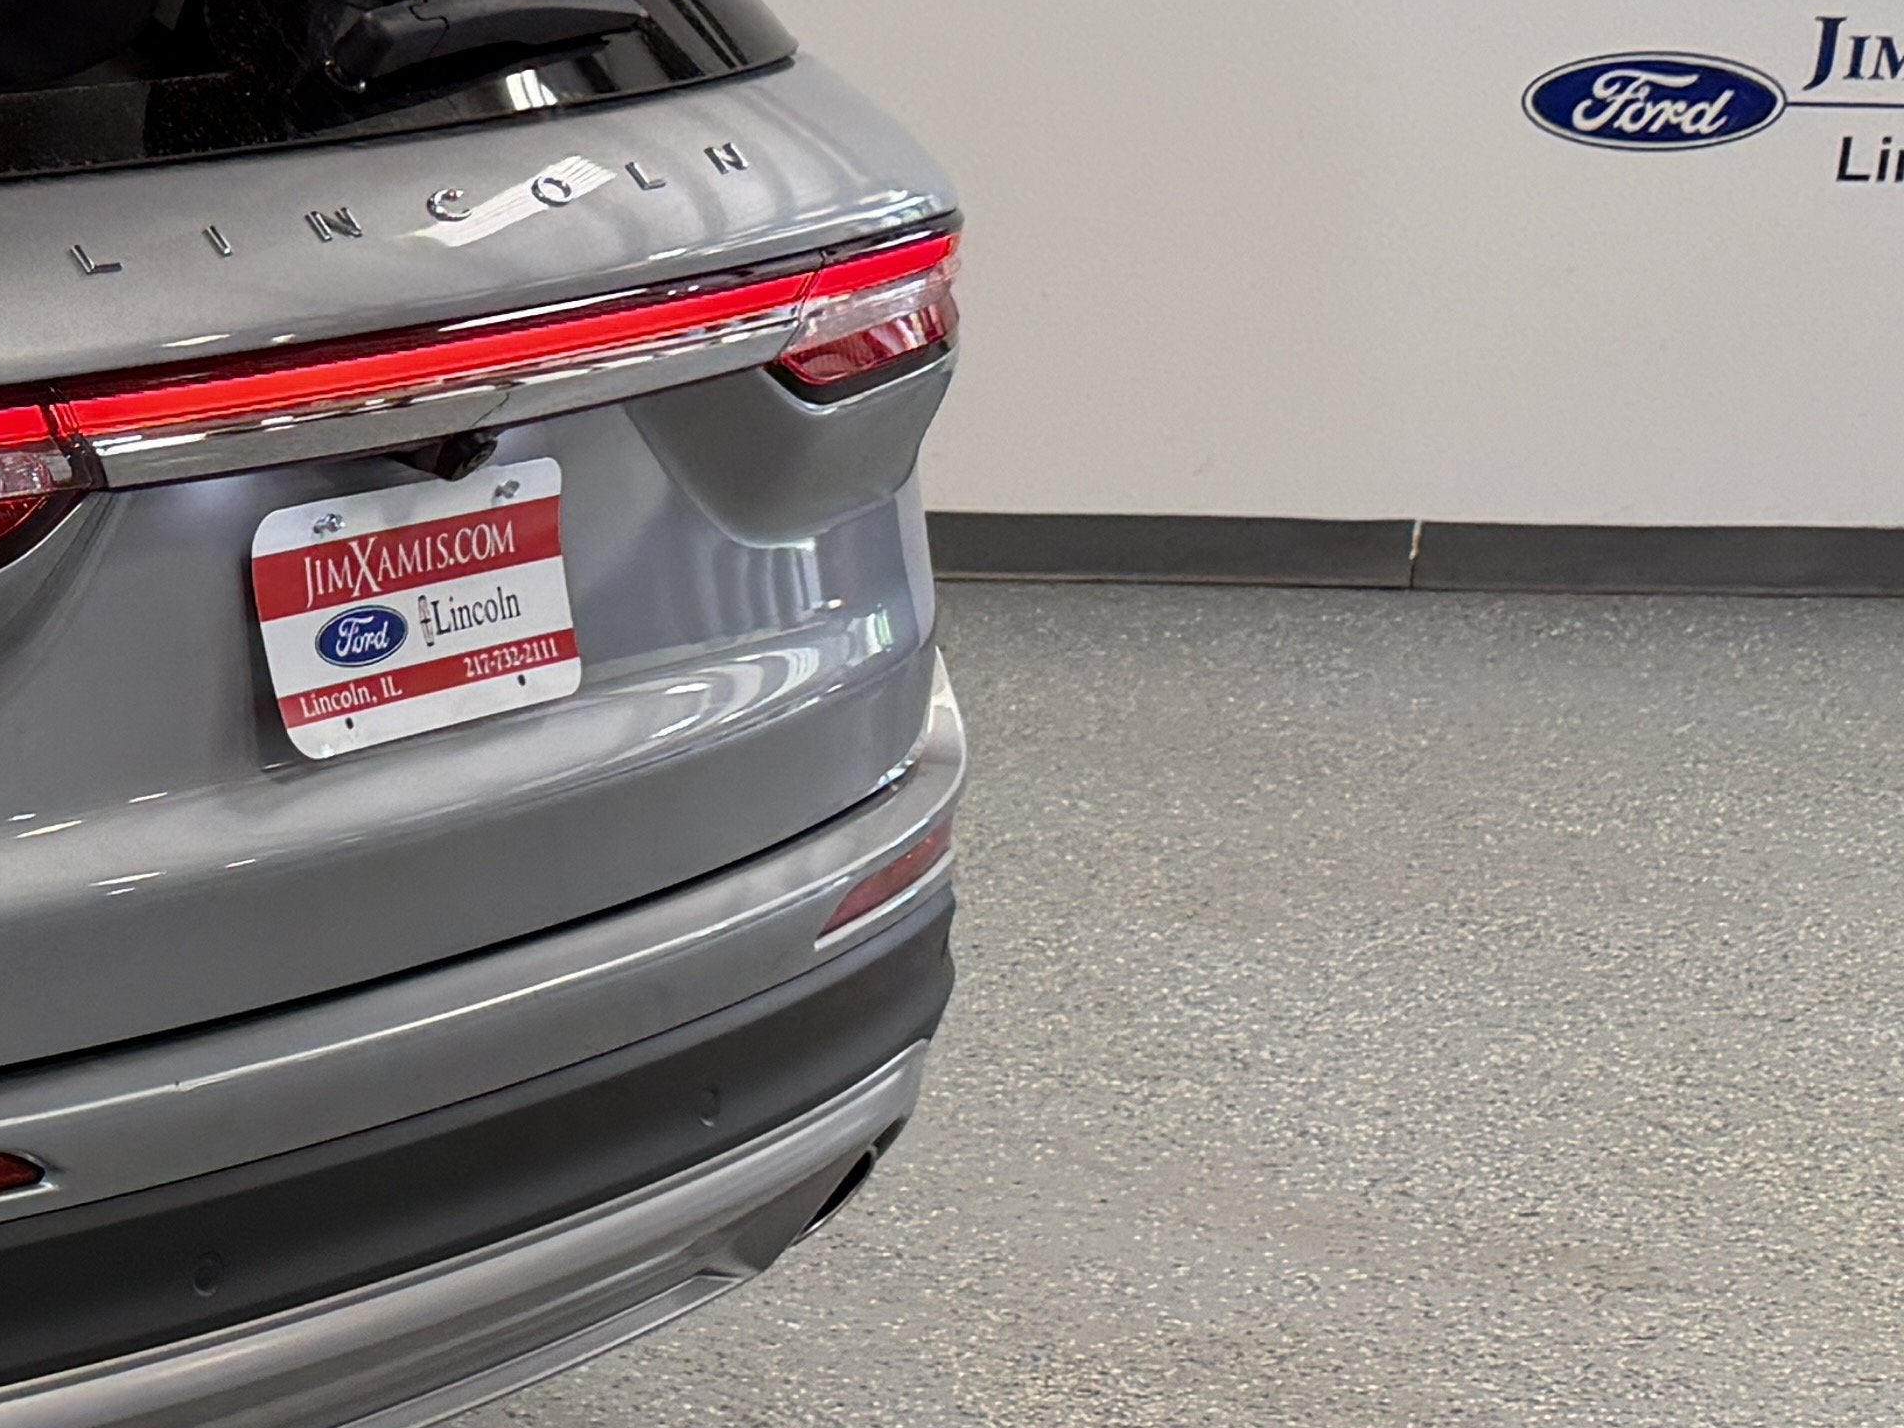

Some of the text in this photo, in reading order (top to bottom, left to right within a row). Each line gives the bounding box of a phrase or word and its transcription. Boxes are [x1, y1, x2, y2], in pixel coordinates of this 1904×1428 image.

[1572, 69, 1735, 135] Ford
[69, 141, 751, 276] LINCOLN
[430, 585, 521, 636] Lincoln
[463, 637, 559, 678] 217-732-2111
[299, 675, 403, 718] Lincoln, IL
